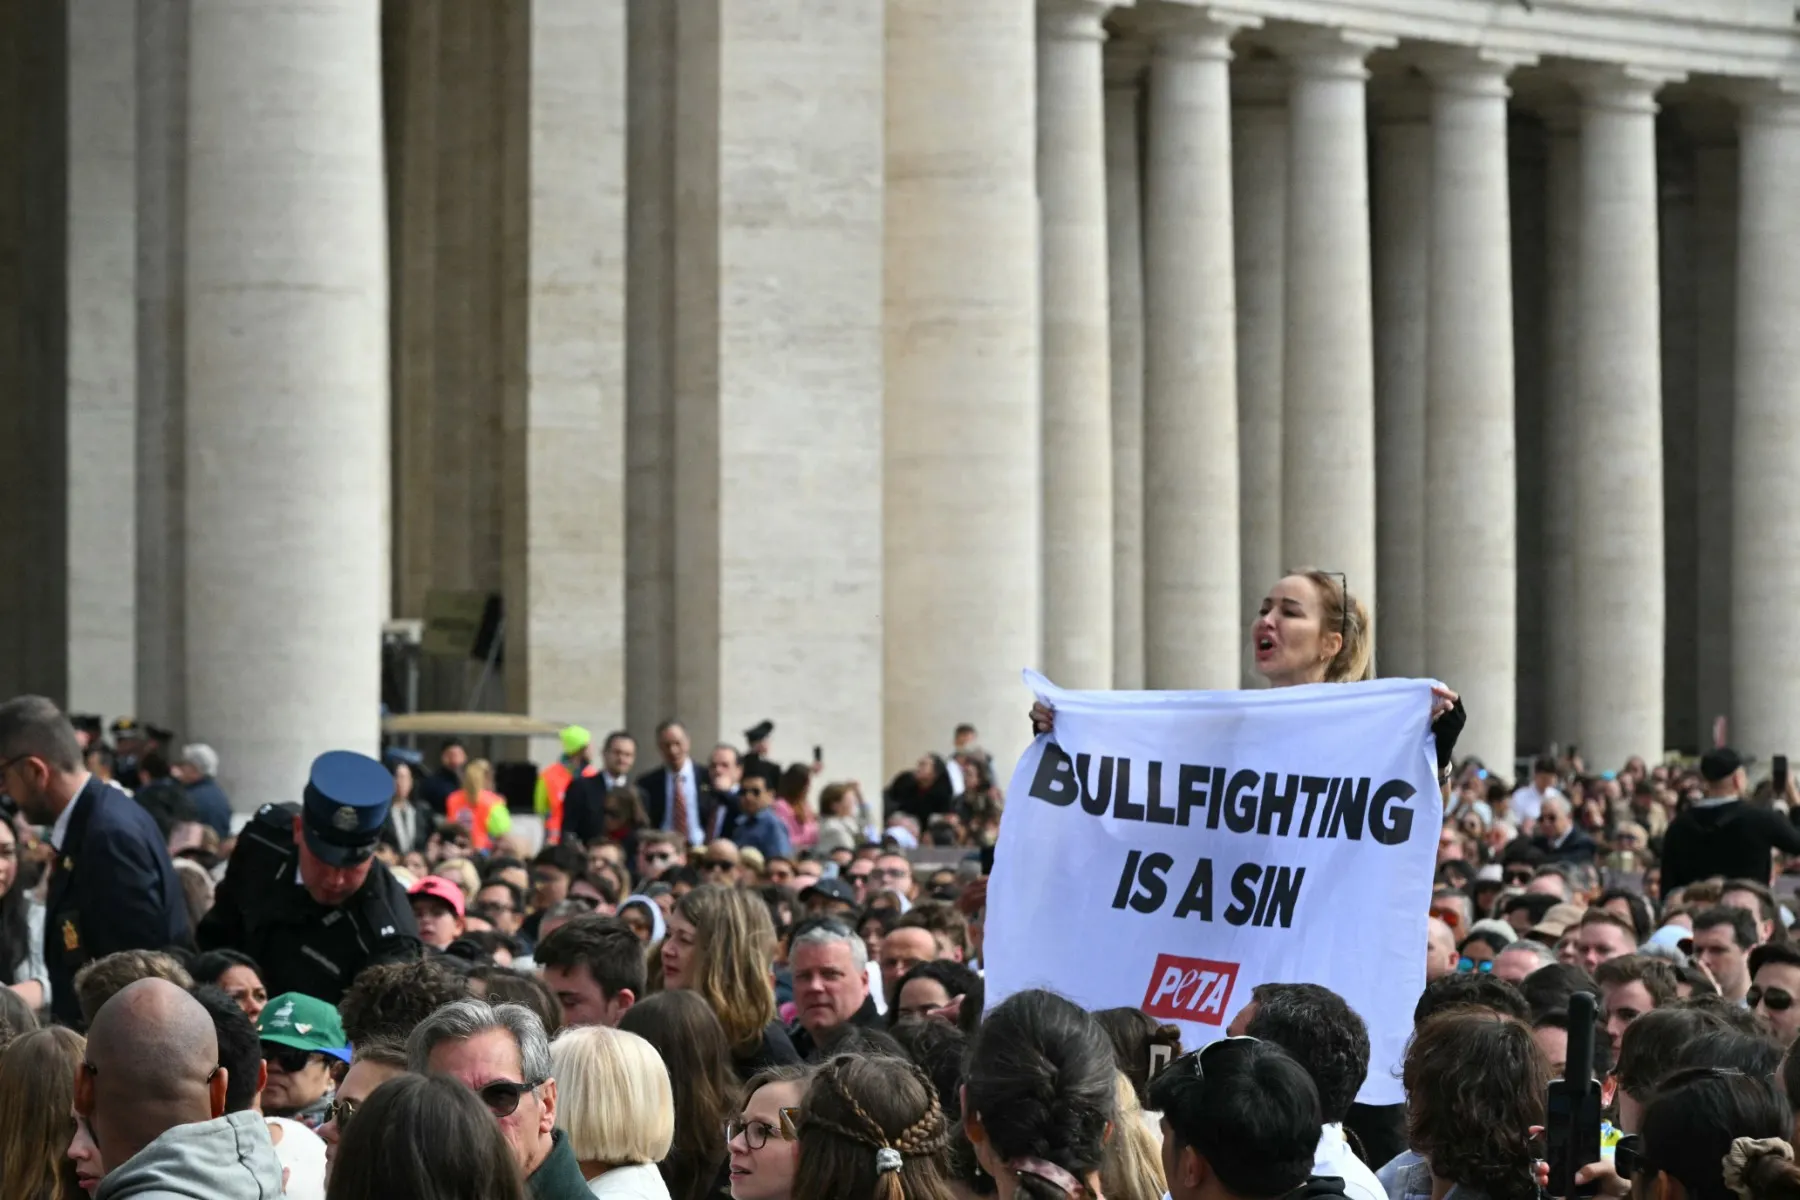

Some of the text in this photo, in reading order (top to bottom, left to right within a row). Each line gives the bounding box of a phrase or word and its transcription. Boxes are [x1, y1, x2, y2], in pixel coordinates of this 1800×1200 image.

[1028, 740, 1418, 846] BULLFIGHTING
[1111, 849, 1307, 929] IS A SIN
